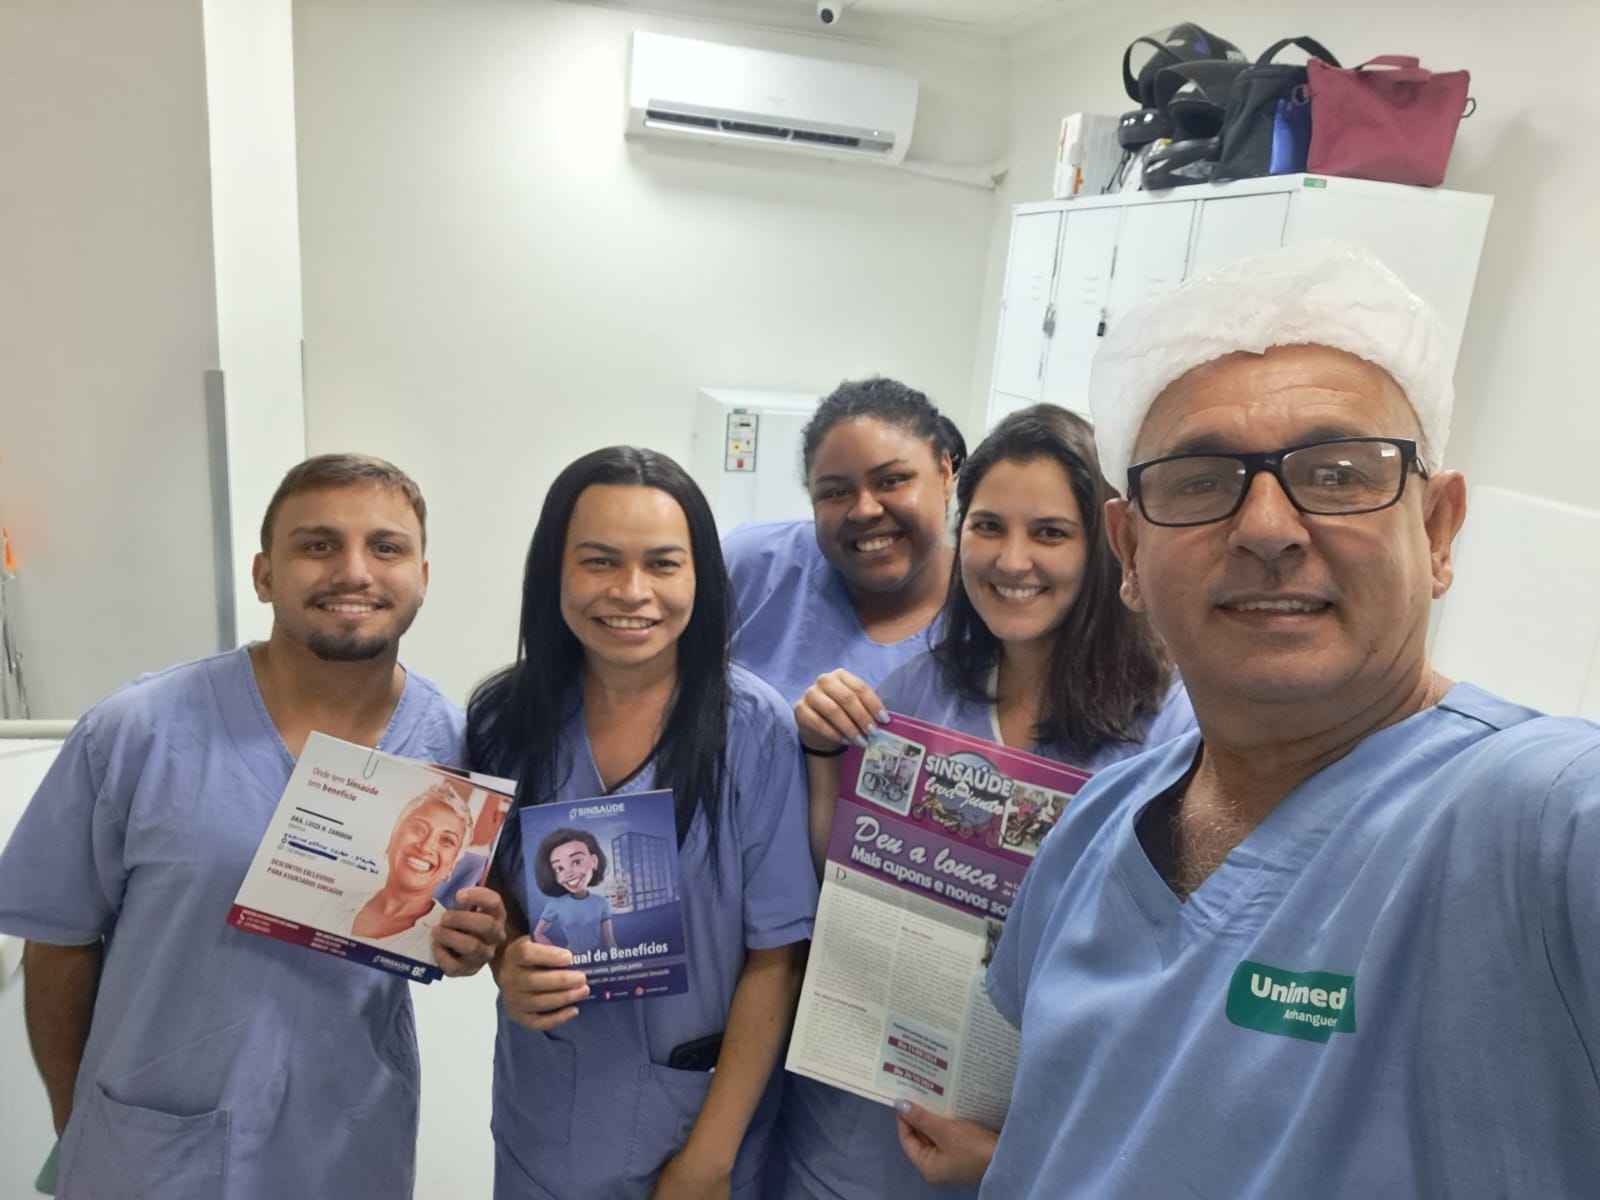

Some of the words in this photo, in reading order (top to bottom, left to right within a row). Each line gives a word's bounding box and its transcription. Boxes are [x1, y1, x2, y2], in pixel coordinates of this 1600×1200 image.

[312, 767, 331, 780] Onde
[345, 778, 379, 796] Sinsaúde
[925, 755, 1013, 798] SINSAÚDE
[578, 802, 625, 817] SINSAÚDE
[854, 816, 903, 855] Deu
[909, 847, 928, 865] a
[933, 848, 998, 891] louca
[267, 866, 283, 877] PARA
[851, 844, 882, 869] Mais
[883, 860, 933, 889] cupons
[933, 879, 944, 893] e
[945, 883, 990, 910] novos
[990, 901, 1008, 916] so
[593, 949, 608, 962] de
[609, 941, 669, 960] Benefícios
[1250, 973, 1348, 1010] Unimed
